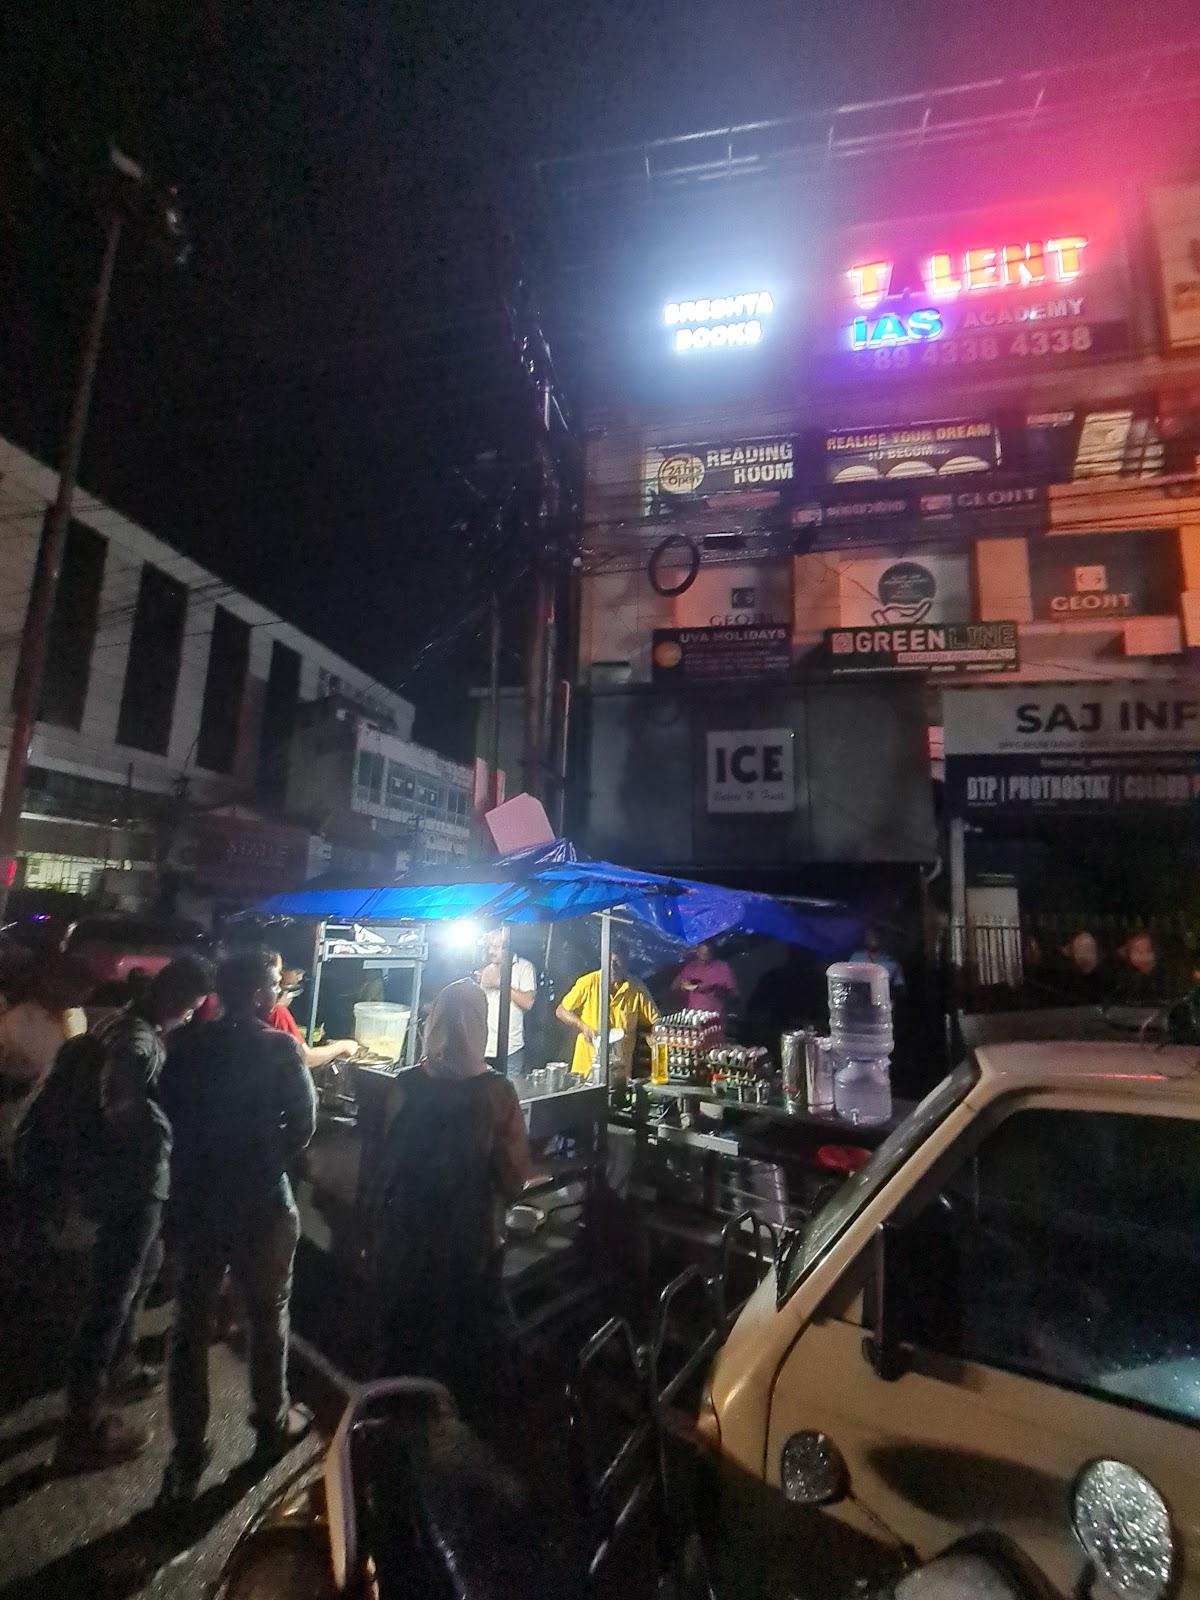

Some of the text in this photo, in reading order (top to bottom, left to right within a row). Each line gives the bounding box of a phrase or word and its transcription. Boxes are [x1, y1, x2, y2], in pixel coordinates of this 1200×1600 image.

[846, 234, 1089, 306] TLENT
[963, 298, 1085, 328] ACADEMY
[676, 319, 762, 351] BOOKS
[1011, 325, 1093, 356] 4338
[826, 431, 886, 450] REALISE
[935, 423, 991, 441] DREAM
[706, 441, 793, 468] READING
[733, 461, 794, 484] ROOM
[713, 628, 786, 642] HOLIDAYS
[1016, 702, 1103, 734] SAJ
[715, 744, 784, 784] ICE
